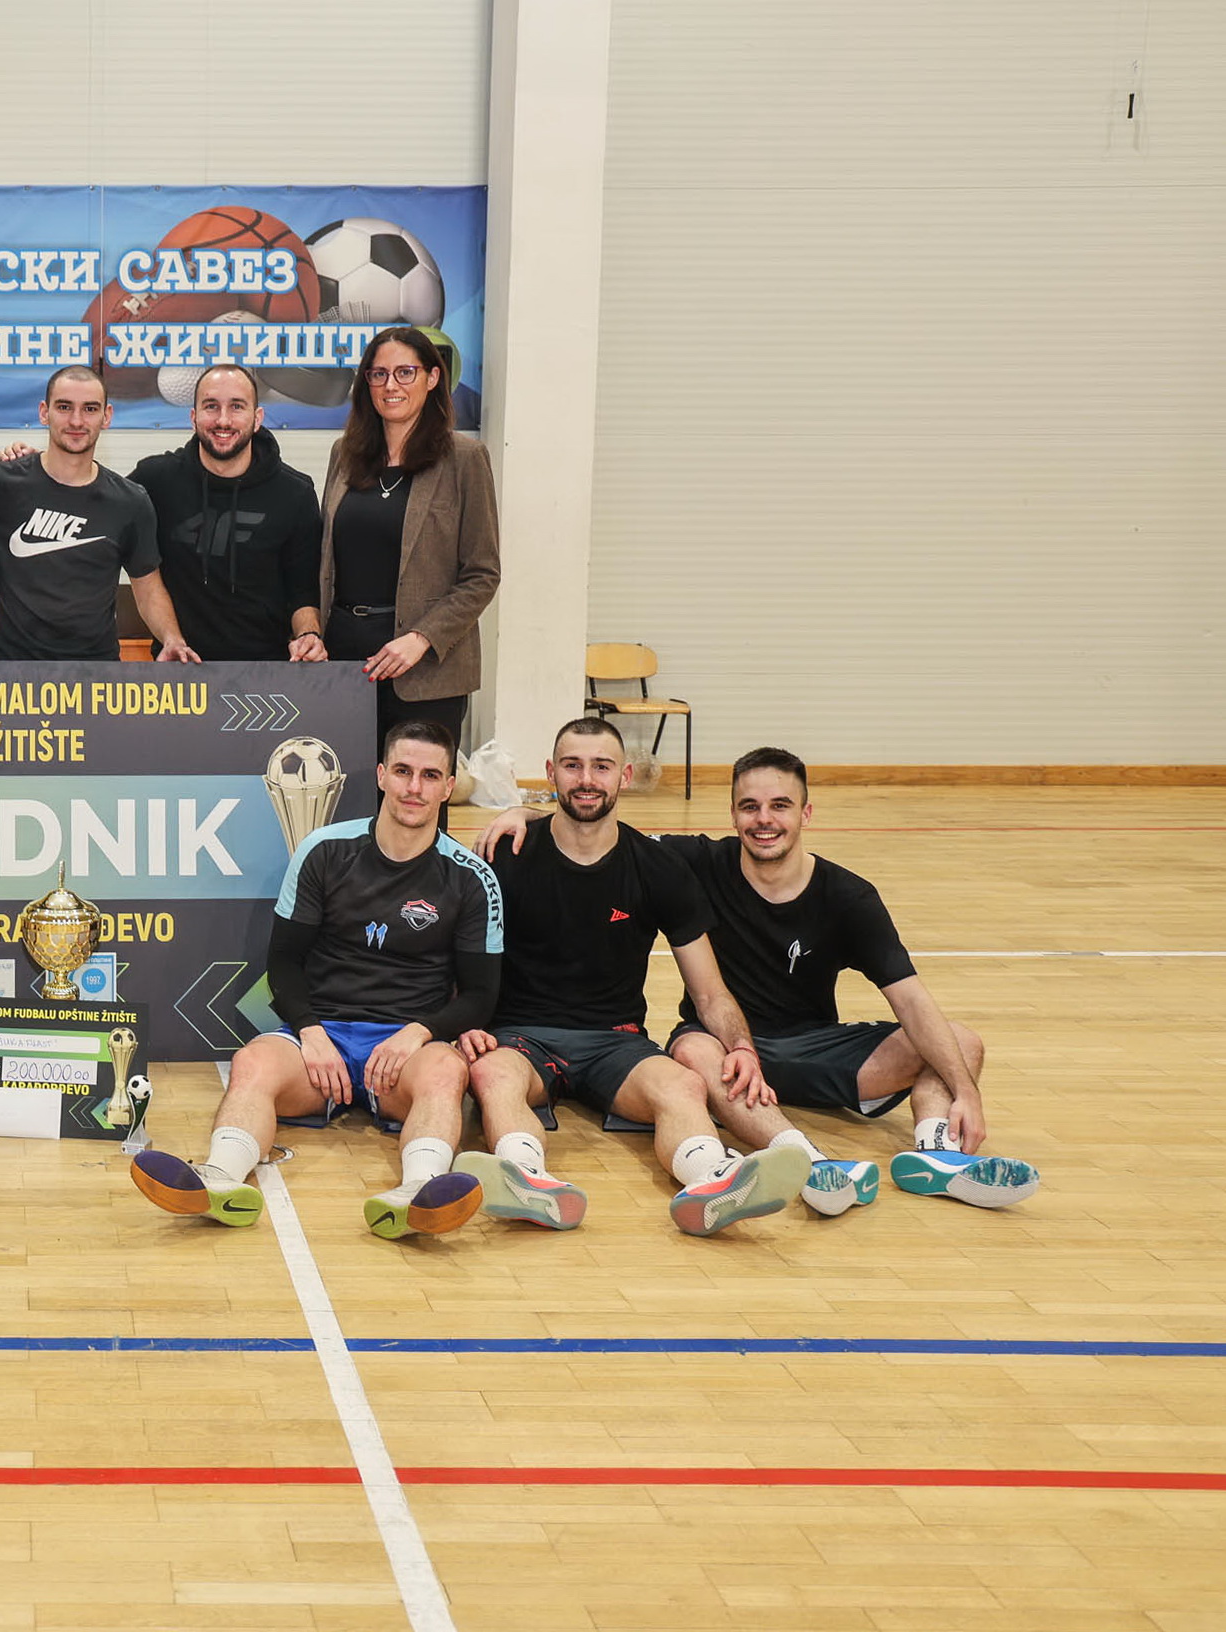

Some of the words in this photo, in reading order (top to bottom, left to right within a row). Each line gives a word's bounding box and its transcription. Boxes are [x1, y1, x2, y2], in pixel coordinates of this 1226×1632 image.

[118, 249, 297, 292] САВЕЗ
[106, 324, 382, 366] ЖИТИШТ
[23, 508, 88, 541] NIKE
[91, 682, 208, 716] FUDBALU
[14, 1008, 56, 1020] FUDBALU
[58, 1008, 100, 1021] OPŠTINE
[101, 1009, 137, 1023] ŽITIŠTE
